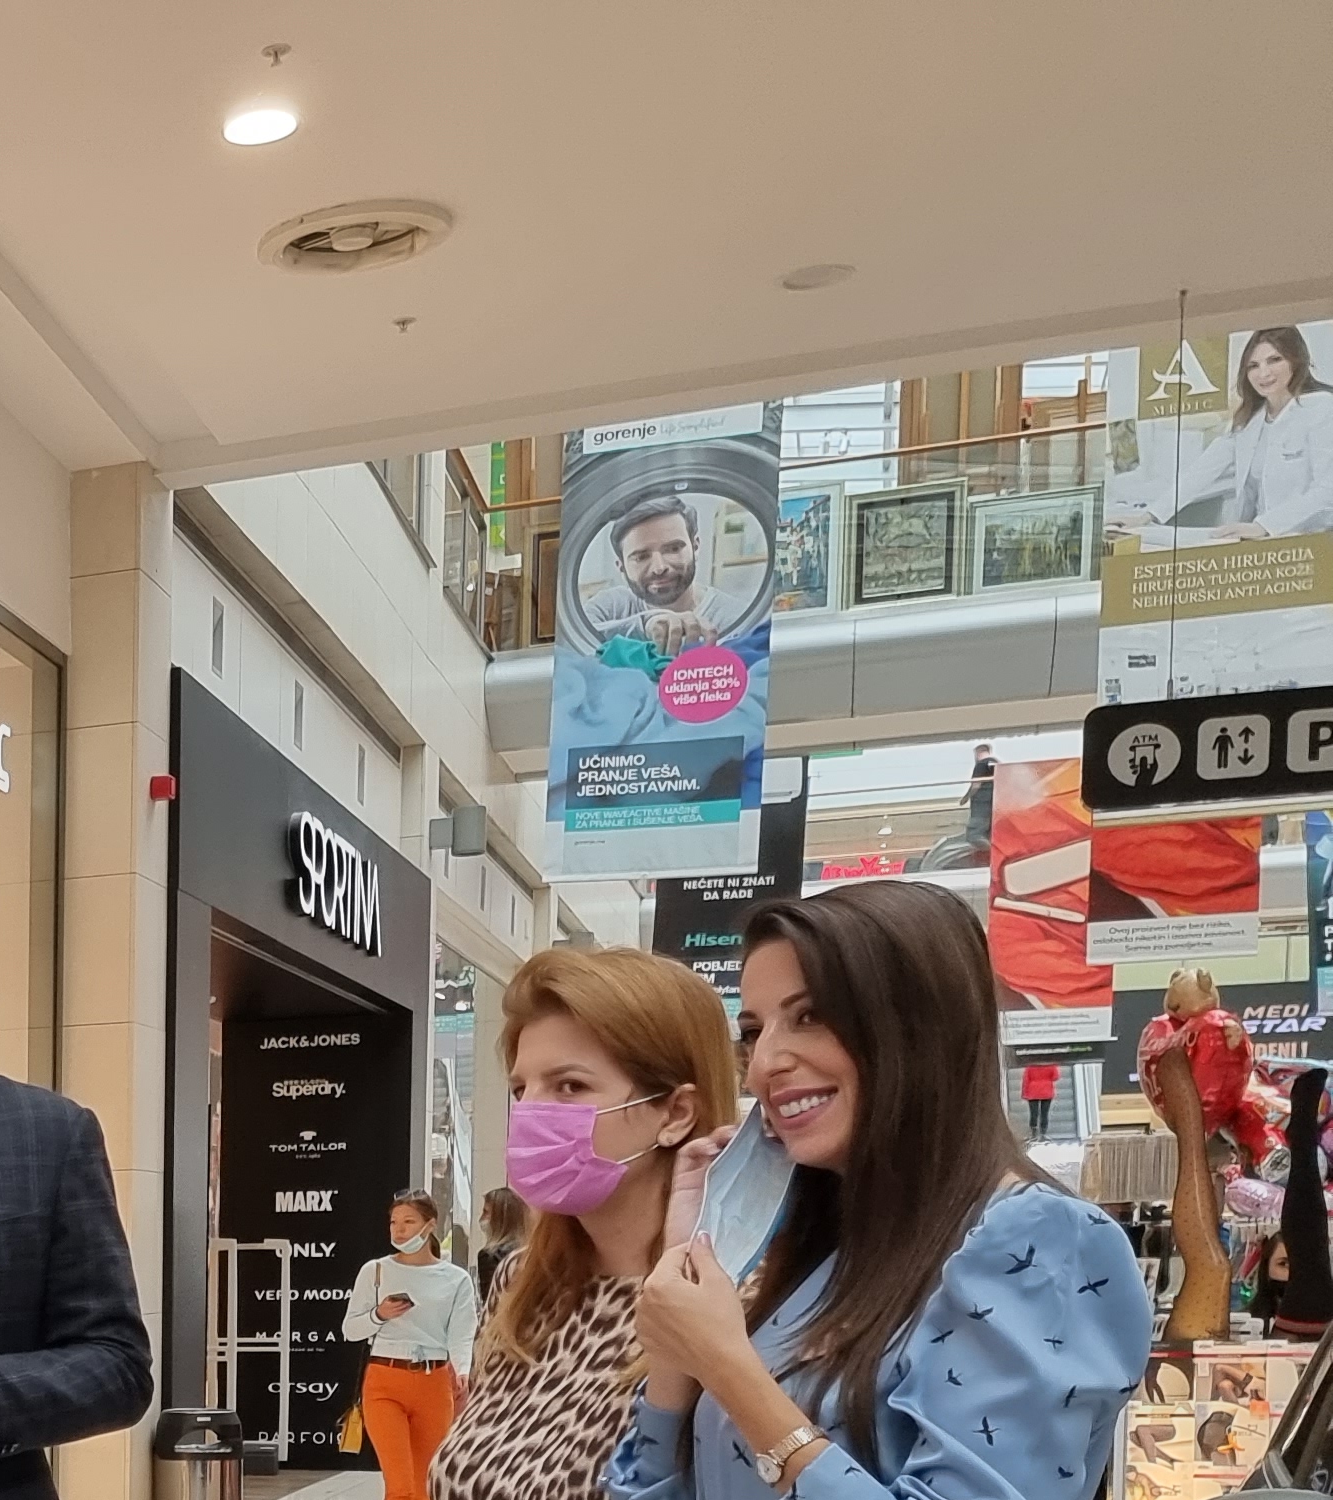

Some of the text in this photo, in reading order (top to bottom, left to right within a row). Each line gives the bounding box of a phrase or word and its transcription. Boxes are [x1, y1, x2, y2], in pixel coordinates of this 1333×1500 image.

[1153, 399, 1213, 417] MEDIC
[593, 423, 657, 446] gorenje
[1134, 548, 1315, 580] ESTETSKA HIRURGIJA
[1208, 569, 1272, 586] TUMORA
[1276, 563, 1315, 579] KOŽE
[1132, 578, 1314, 609] NEHIRURŠKI ANTI AGING
[673, 664, 733, 681] IONTECH
[664, 677, 740, 694] uklanja 30%
[1132, 733, 1159, 743] ATM
[578, 754, 646, 769] UČINIMO
[577, 764, 682, 783] PRANJE VEŠA
[576, 778, 701, 797] JEDNOSTAVNIM.
[575, 805, 701, 820] NOVE WAVEACTIVE MAŠINE
[575, 820, 588, 829] ZA
[589, 818, 625, 828] PRANJE
[633, 814, 675, 826] SUŠENJE
[727, 878, 740, 888] NI
[742, 875, 775, 887] ZNATI
[703, 889, 754, 901] DA RADE
[684, 933, 743, 948] Hisen
[1243, 1002, 1310, 1020] MEDI
[1242, 1016, 1327, 1035] STAR
[260, 1033, 361, 1050] JACK&JONES
[272, 1081, 346, 1100] Superdry.
[269, 1142, 347, 1153] TOM TAILOR
[275, 1190, 333, 1213] MARX
[303, 1289, 354, 1301] MODA
